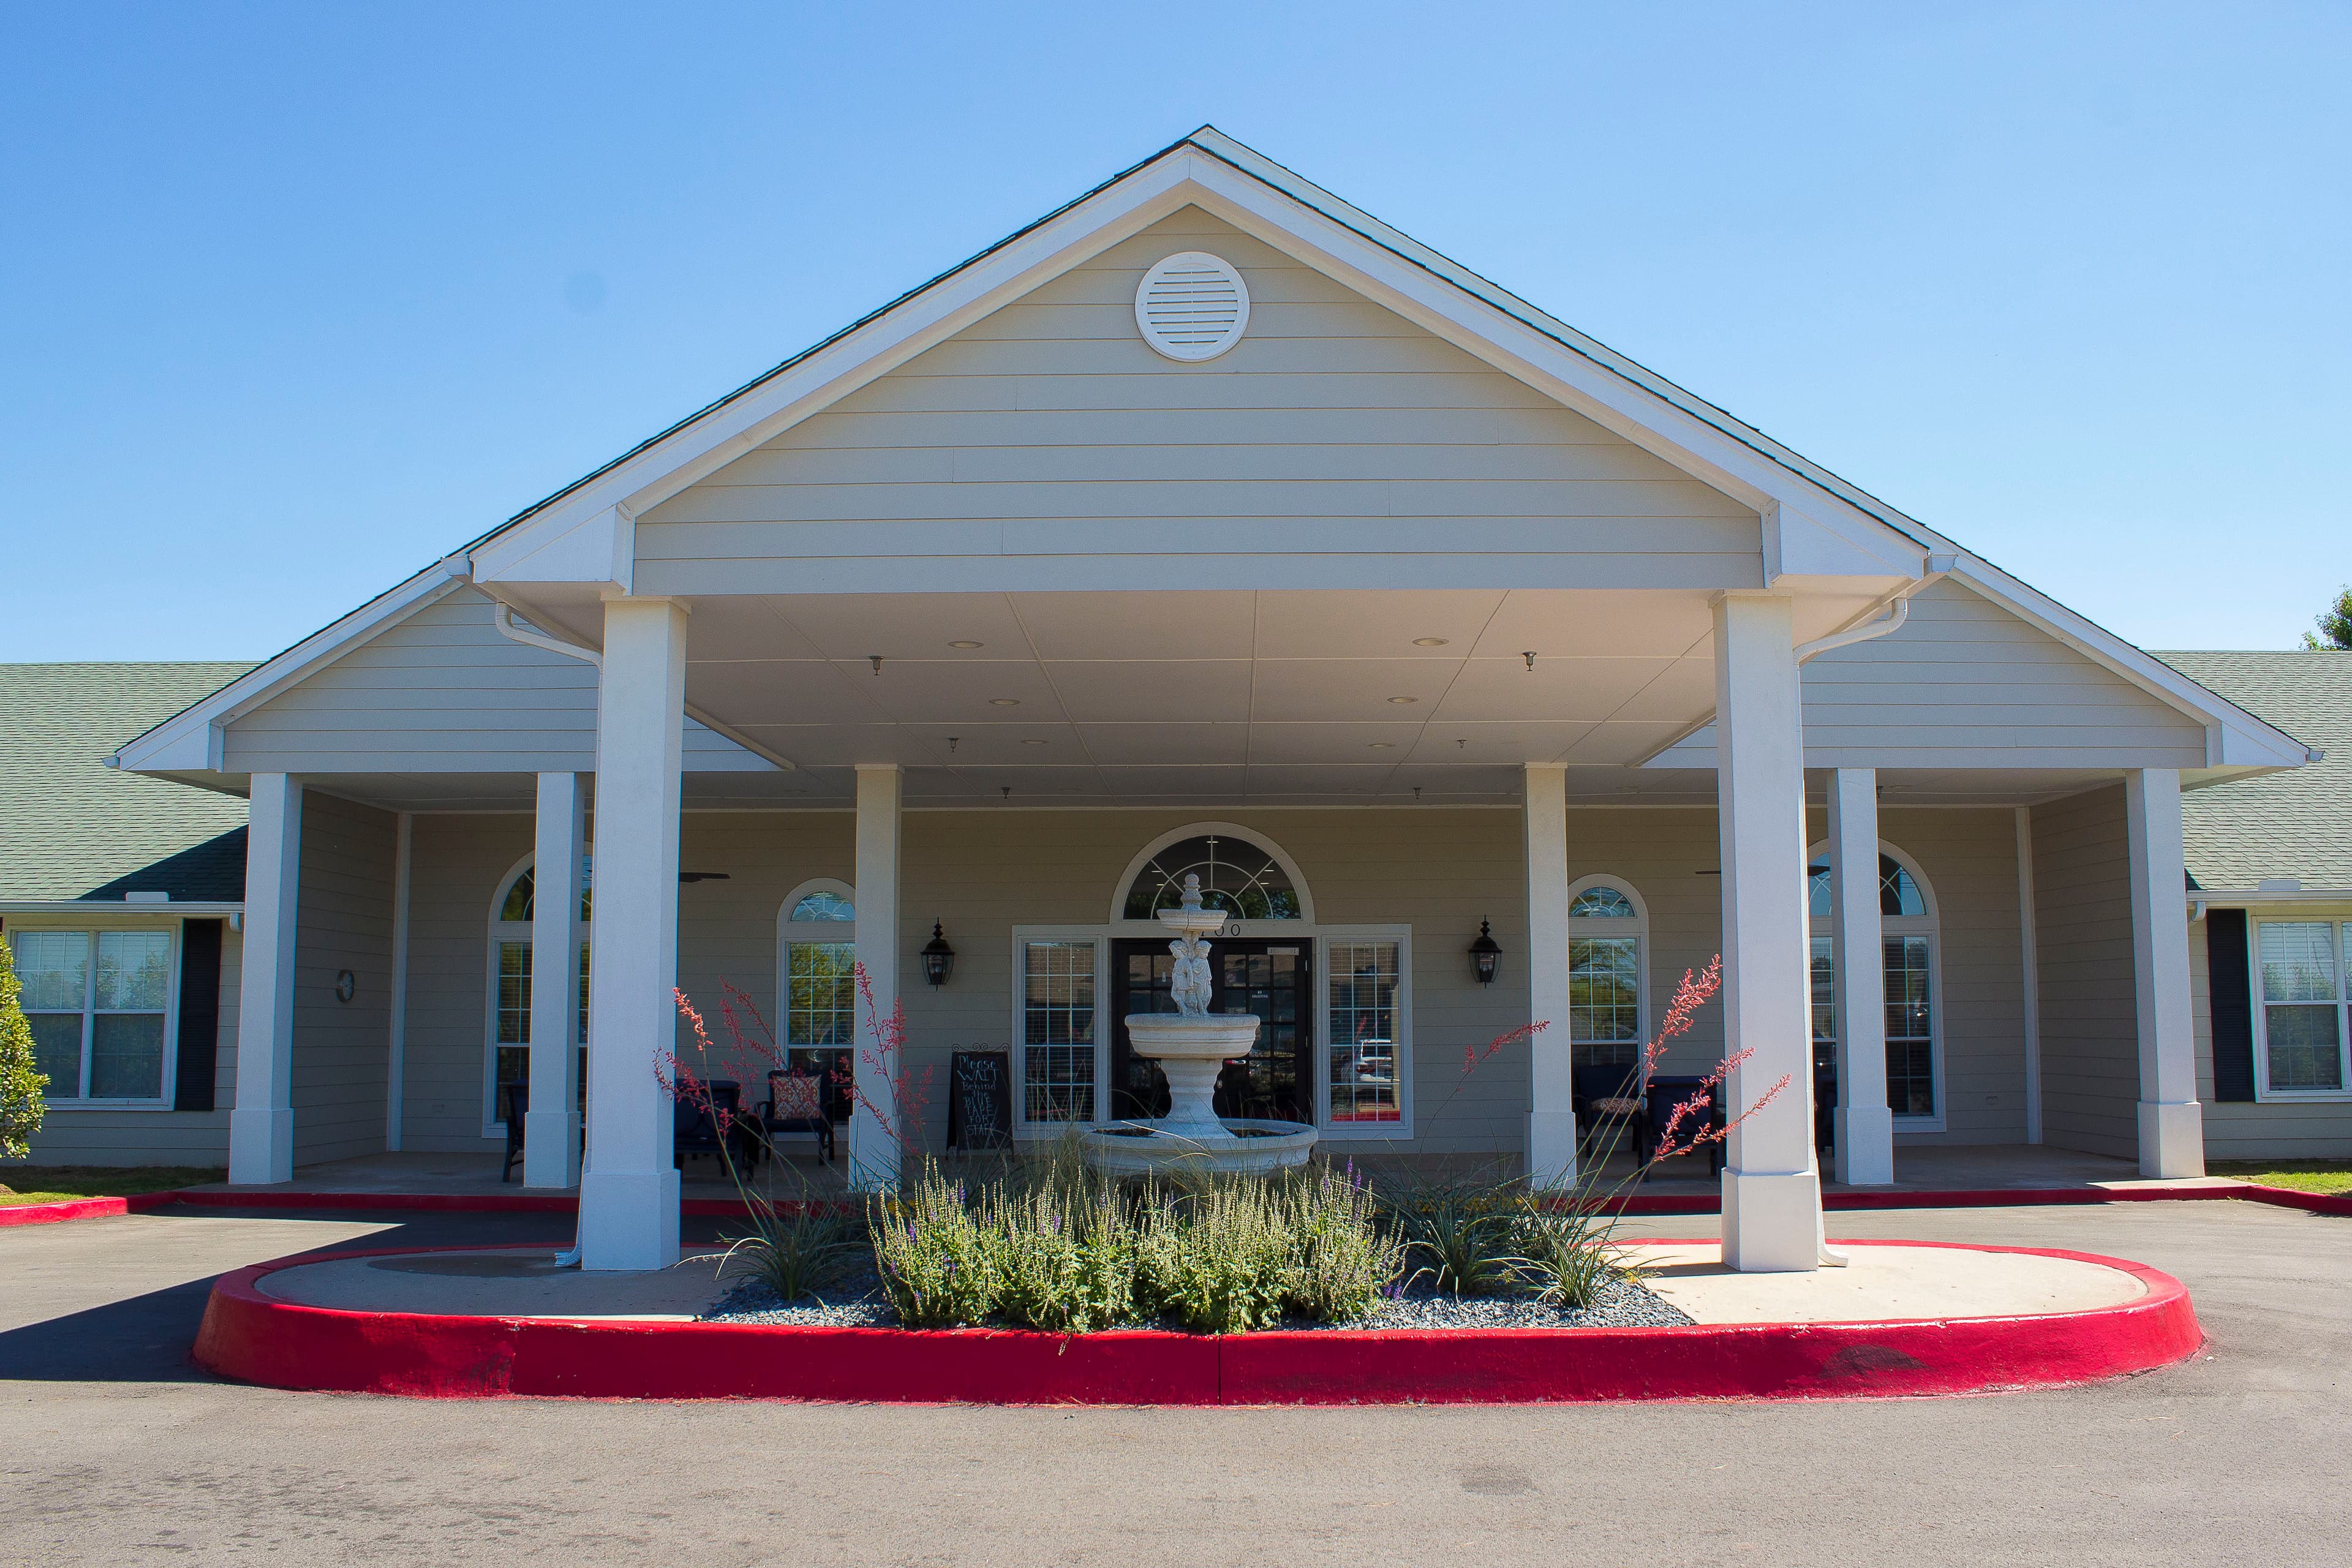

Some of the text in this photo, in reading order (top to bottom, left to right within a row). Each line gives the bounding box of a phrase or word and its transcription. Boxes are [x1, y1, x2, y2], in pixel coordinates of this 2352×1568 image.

[959, 1055, 996, 1069] Please
[956, 1068, 1000, 1082] WAIT
[962, 1080, 997, 1091] Behind
[972, 1090, 989, 1098] the
[963, 1096, 993, 1107] BLUE
[964, 1106, 995, 1117] TAPE
[970, 1115, 990, 1124] FOR
[967, 1123, 995, 1137] STAFF
